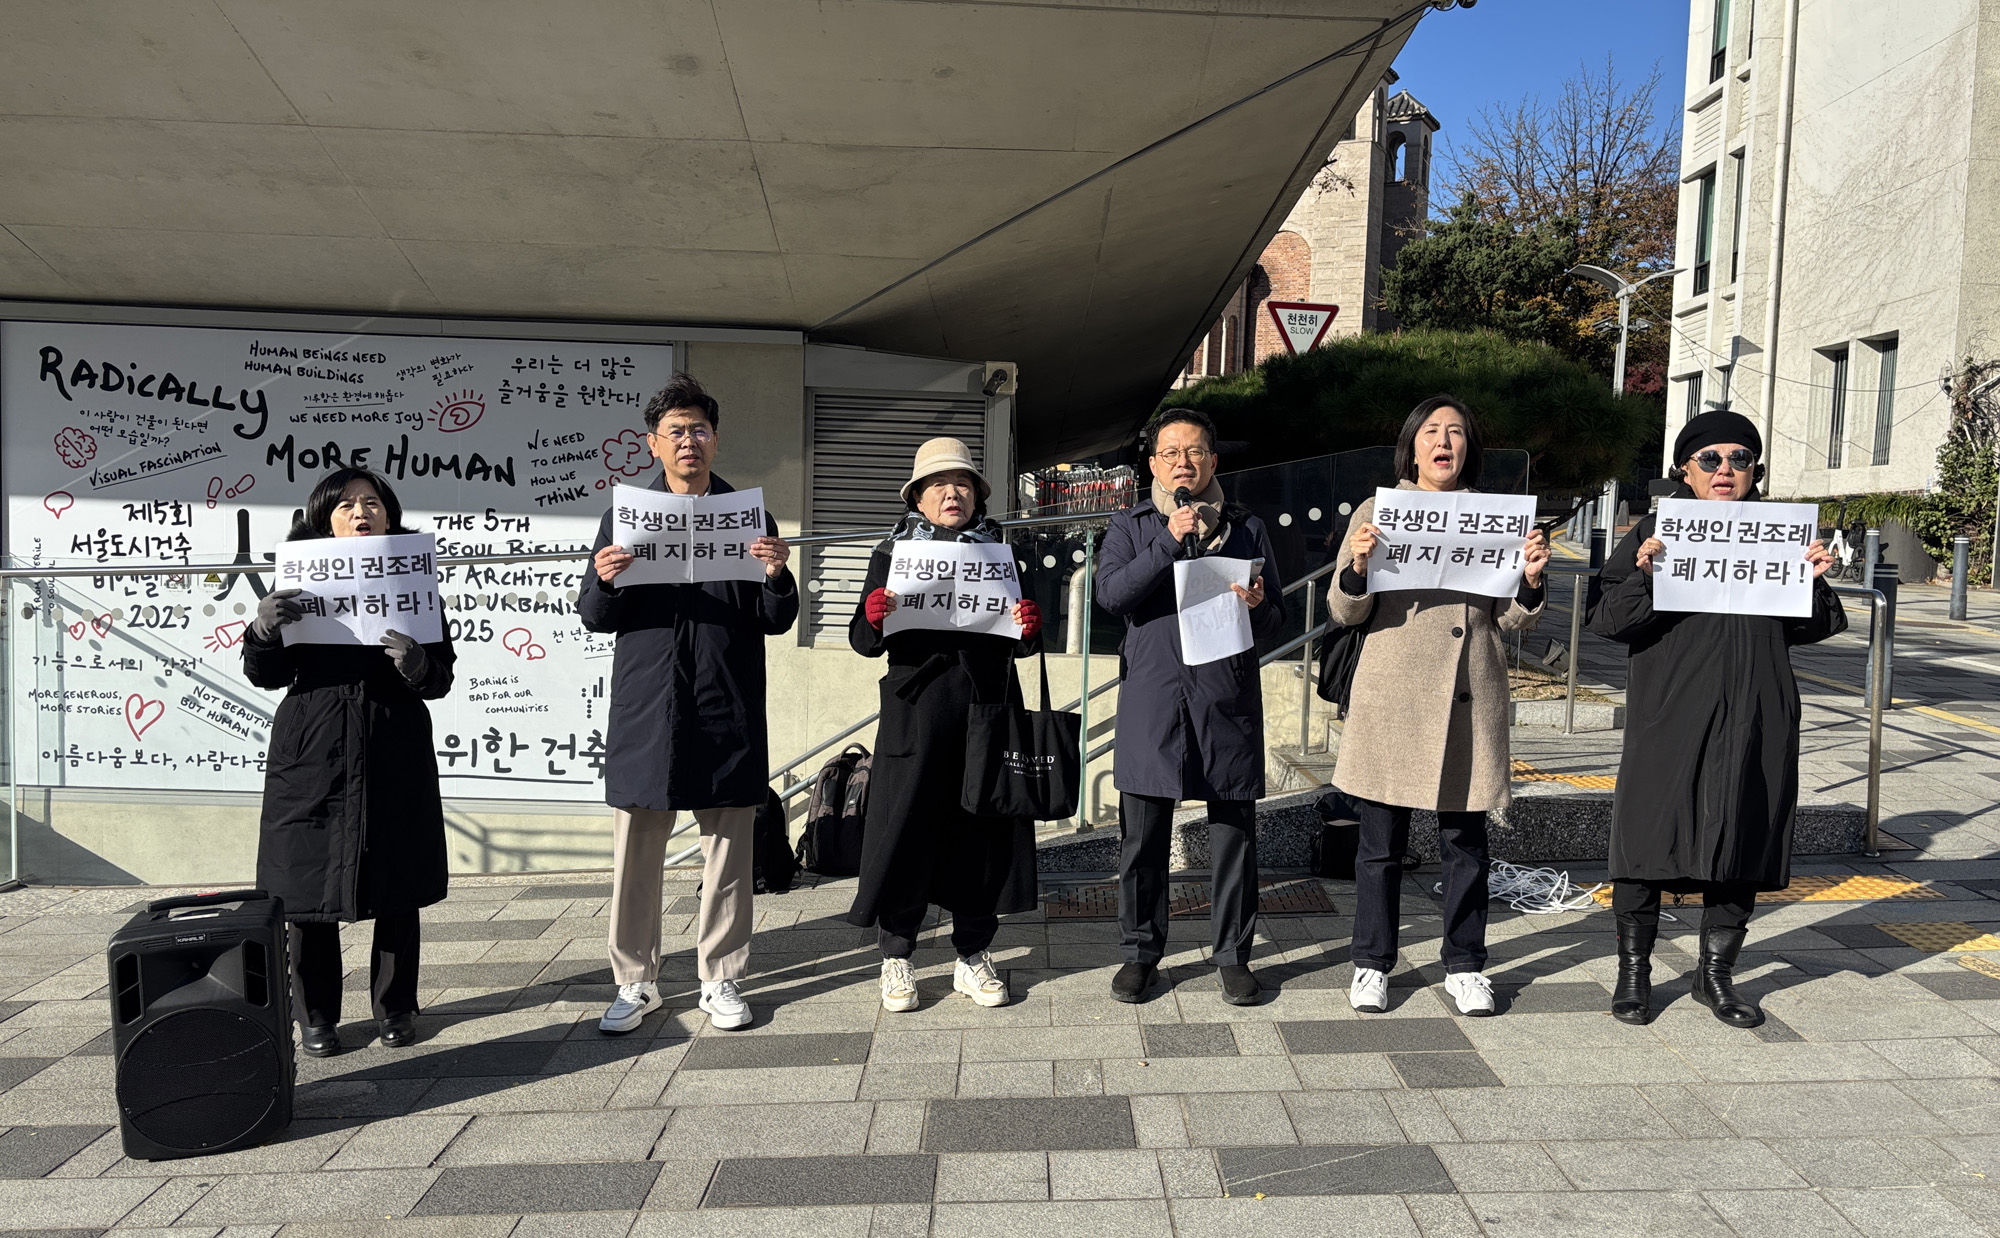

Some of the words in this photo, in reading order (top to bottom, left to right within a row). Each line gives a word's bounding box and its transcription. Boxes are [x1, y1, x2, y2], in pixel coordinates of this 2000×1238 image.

[1287, 313, 1318, 327] 천천히
[1290, 326, 1315, 335] SLOW
[250, 340, 298, 359] HUMAN
[303, 348, 348, 362] BEINGS
[353, 352, 387, 364] NEED
[244, 360, 292, 376] HUMAN
[297, 366, 364, 384] BUILDINGS
[396, 364, 427, 381] 생각의
[430, 353, 461, 370] 변화가
[432, 364, 474, 387] 필요하다
[511, 354, 564, 375] 우리는
[574, 356, 591, 372] 더
[601, 356, 636, 381] 많은
[303, 394, 339, 403] 지루함은
[342, 392, 372, 402] 환경에
[374, 389, 405, 402] 해롭다
[498, 379, 569, 408] 즐거움을
[577, 384, 640, 408] 원한다!
[90, 425, 113, 437] 어떤
[94, 410, 130, 423] 사람이
[135, 414, 168, 430] 건물이
[172, 417, 208, 433] 된다면
[290, 412, 308, 423] WE
[313, 412, 347, 424] NEED
[352, 411, 389, 422] MORE
[394, 412, 424, 431] JOY
[527, 429, 549, 450] WE
[553, 432, 585, 447] NEED
[89, 467, 137, 487] VISUAL
[139, 441, 222, 473] FASCINATION
[266, 434, 373, 482] MORE
[385, 434, 516, 487] HUMAN
[531, 458, 548, 468] TO
[552, 448, 599, 465] CHANGE
[530, 475, 555, 487] HOW
[560, 471, 576, 481] WE
[535, 485, 589, 507] THINK
[123, 500, 192, 527] 제5회
[433, 514, 476, 531] THE
[483, 508, 530, 533] 5TH
[617, 506, 687, 531] 학생인
[693, 506, 762, 531] 권조례
[1378, 507, 1449, 533] 학생인
[1458, 512, 1529, 538] 권조례
[1661, 518, 1732, 542] 학생인
[1738, 521, 1812, 547] 권조례
[32, 537, 41, 569] ERILE
[70, 527, 192, 567] 서울도시건축
[436, 537, 498, 557] SEOUL
[1386, 543, 1520, 570] 폐지하라!
[282, 557, 354, 582] 학생인
[360, 552, 432, 579] 권조례
[438, 566, 457, 583] OF
[894, 558, 956, 581] 학생인
[962, 561, 1017, 583] 권조례
[1672, 557, 1805, 585] 폐지하라!
[31, 581, 41, 611] FROM
[486, 592, 579, 615] URBANIS
[48, 603, 55, 615] TO
[127, 604, 192, 629] 2025
[449, 619, 494, 642] 025
[552, 630, 564, 643] 천
[584, 640, 616, 653] 사고방
[33, 651, 142, 671] 기능으로서의
[155, 655, 203, 677] '감정'
[28, 688, 59, 699] MORE
[63, 690, 122, 701] GENEROUS,
[469, 676, 508, 690] BORING
[511, 675, 519, 684] IS
[192, 685, 220, 704] NOT
[221, 699, 274, 729] BEAUTIF
[469, 693, 489, 701] BAD
[492, 691, 511, 700] FOR
[514, 689, 533, 698] OUR
[40, 704, 72, 713] MORE
[76, 704, 122, 716] STORIES
[180, 696, 205, 713] BUT
[206, 710, 250, 738] HUMAN
[485, 704, 549, 714] COMMUNITIES
[42, 744, 178, 770] 아름다움보다,
[185, 750, 267, 772] 사람다운
[437, 726, 529, 774] 위한
[541, 729, 607, 779] 건축
